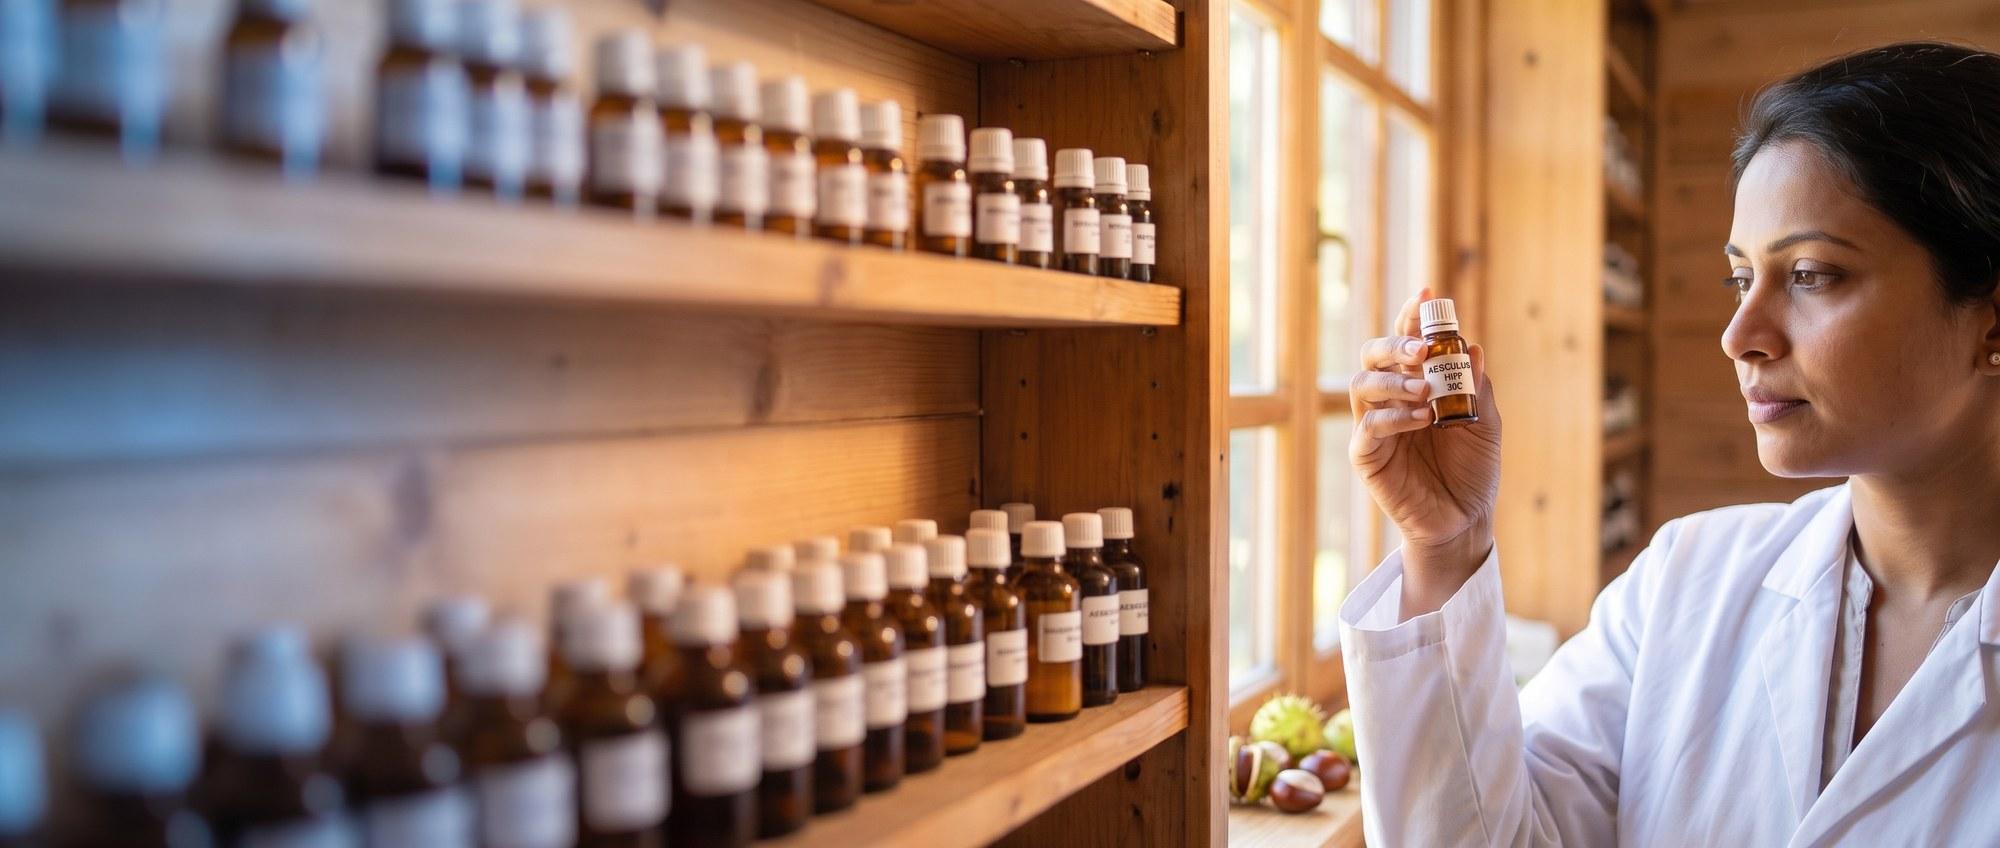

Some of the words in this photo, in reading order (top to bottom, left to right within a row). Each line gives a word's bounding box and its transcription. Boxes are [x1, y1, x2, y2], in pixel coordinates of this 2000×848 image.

[1428, 361, 1471, 374] AESCULUS
[1444, 373, 1462, 381] HIPP
[1447, 382, 1462, 391] 30C
